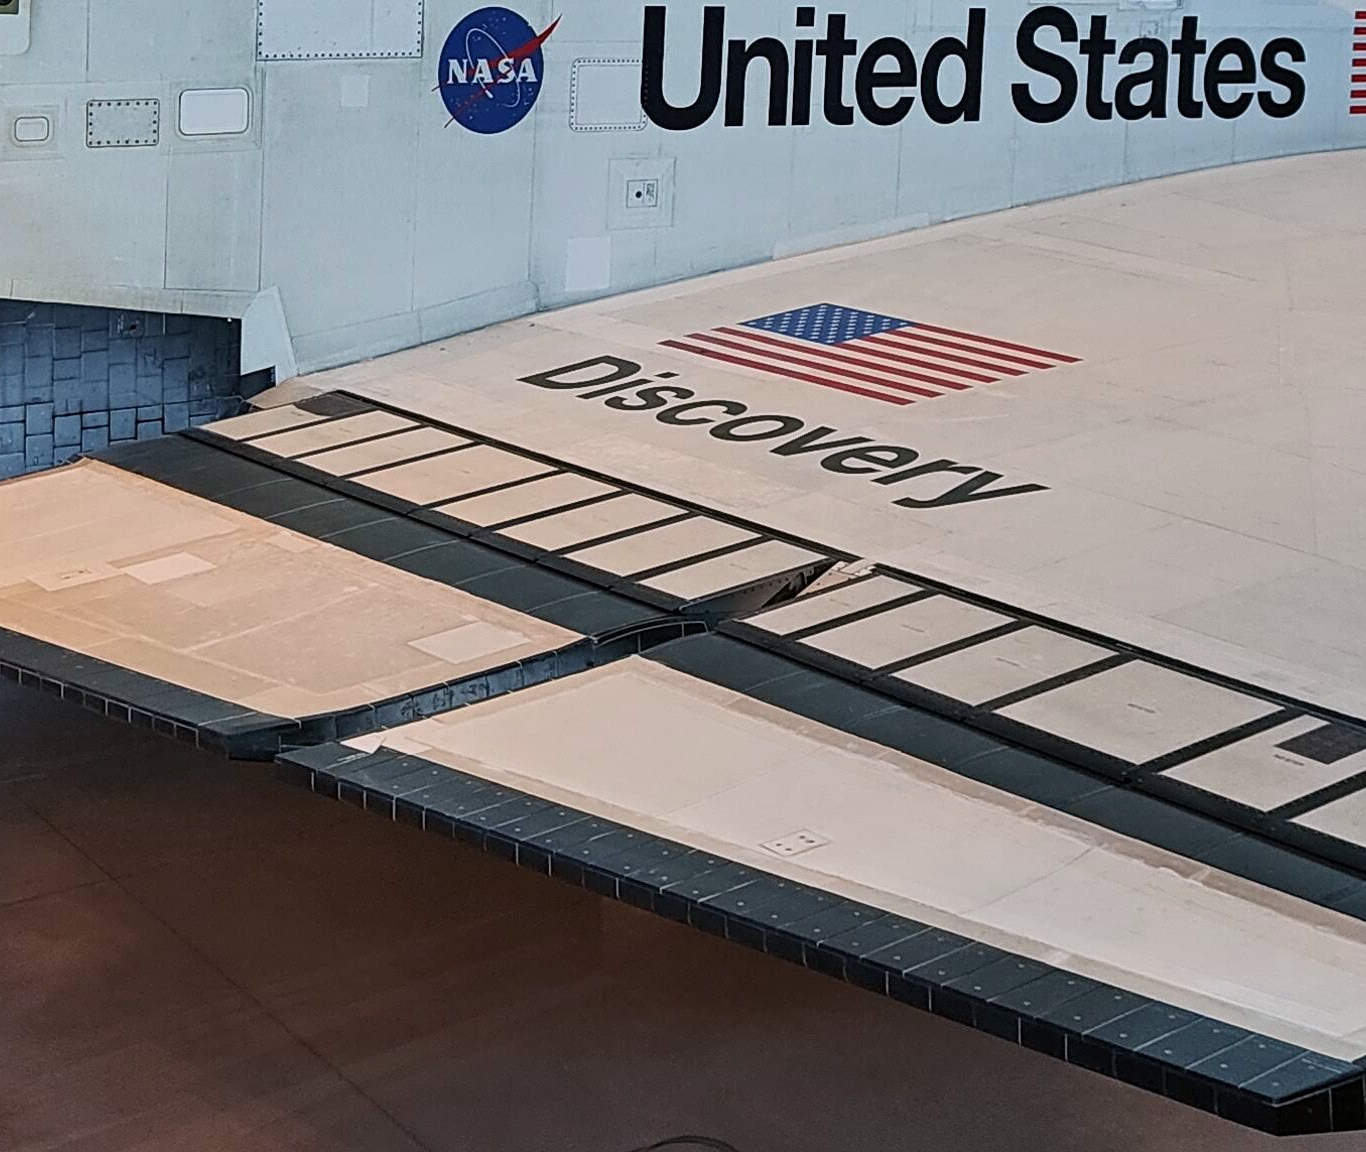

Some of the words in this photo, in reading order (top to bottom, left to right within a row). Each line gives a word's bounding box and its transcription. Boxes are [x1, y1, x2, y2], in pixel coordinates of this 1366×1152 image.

[446, 57, 538, 85] NASA
[640, 5, 986, 131] United
[1011, 5, 1306, 124] States
[515, 354, 1052, 510] Discovery
